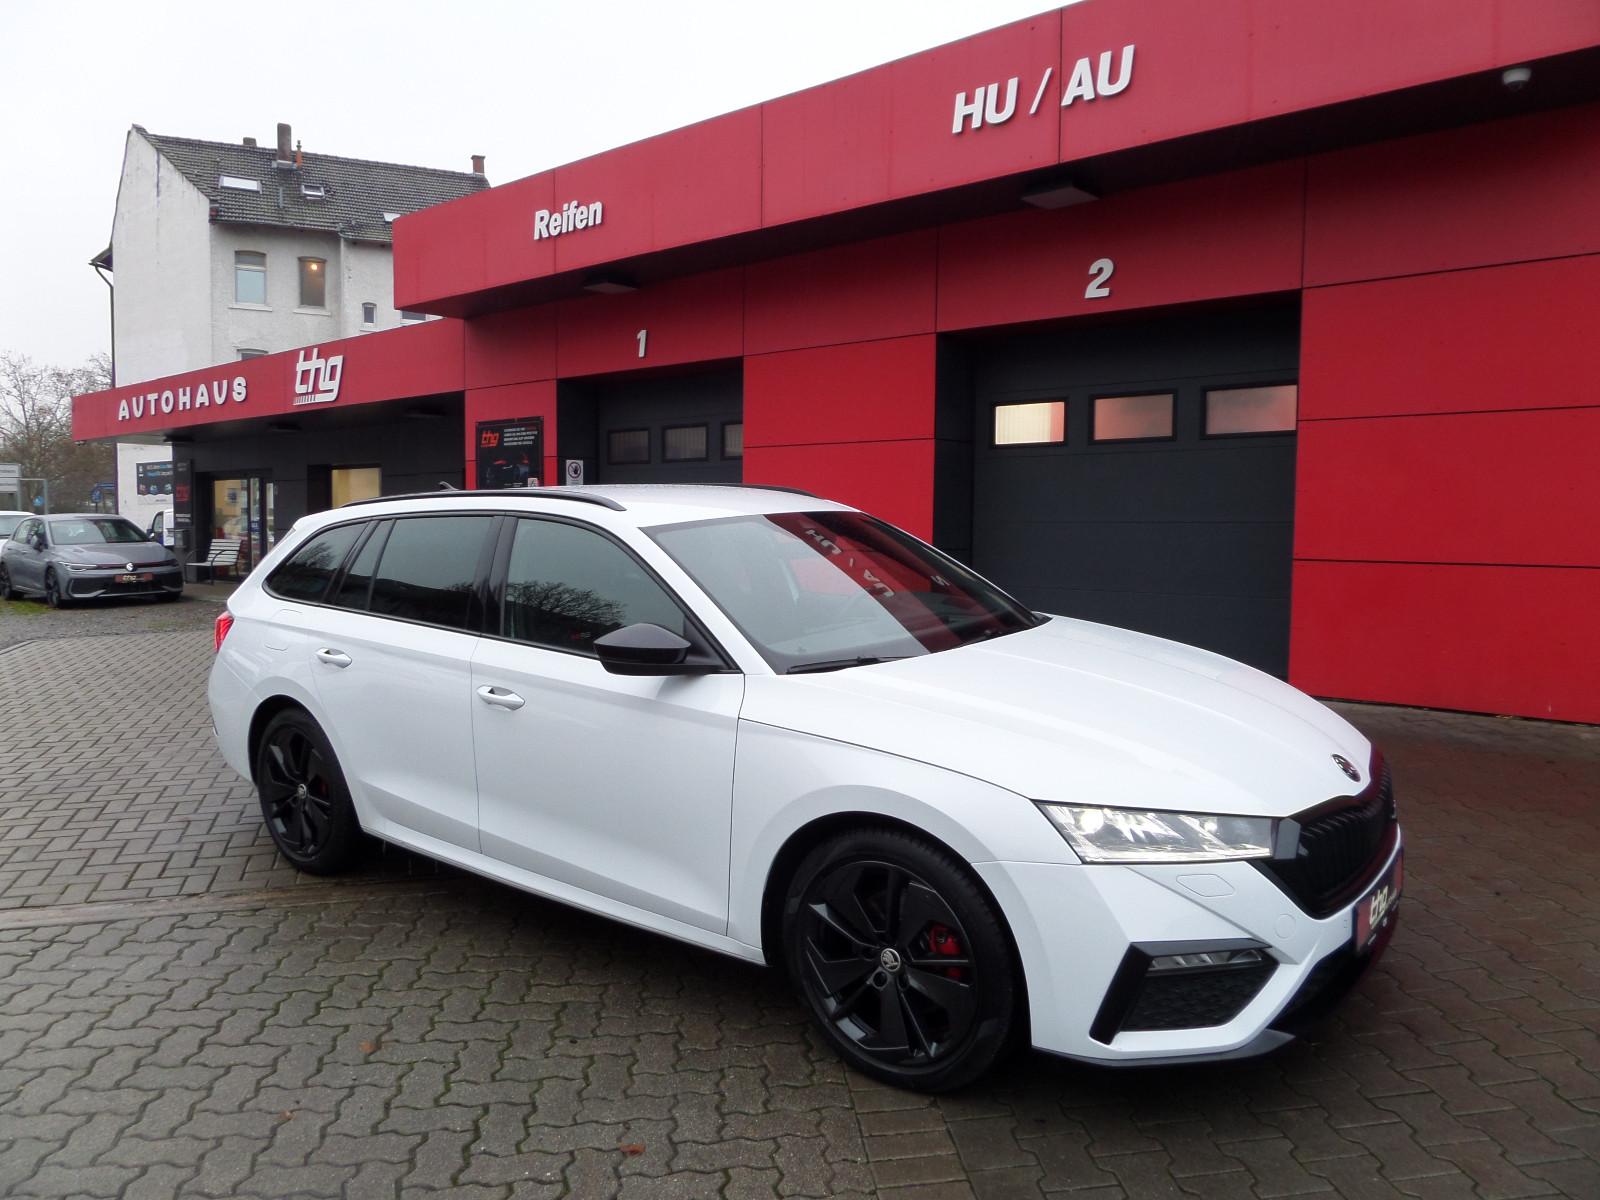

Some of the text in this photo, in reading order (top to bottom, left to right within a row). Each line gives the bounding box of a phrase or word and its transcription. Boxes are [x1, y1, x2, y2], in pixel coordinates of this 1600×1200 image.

[952, 44, 1136, 134] HU / AU
[533, 200, 603, 240] Reifen
[1084, 258, 1115, 299] 2
[636, 329, 648, 358] 1
[118, 376, 248, 421] AUTOHAUS
[293, 348, 345, 406] thg
